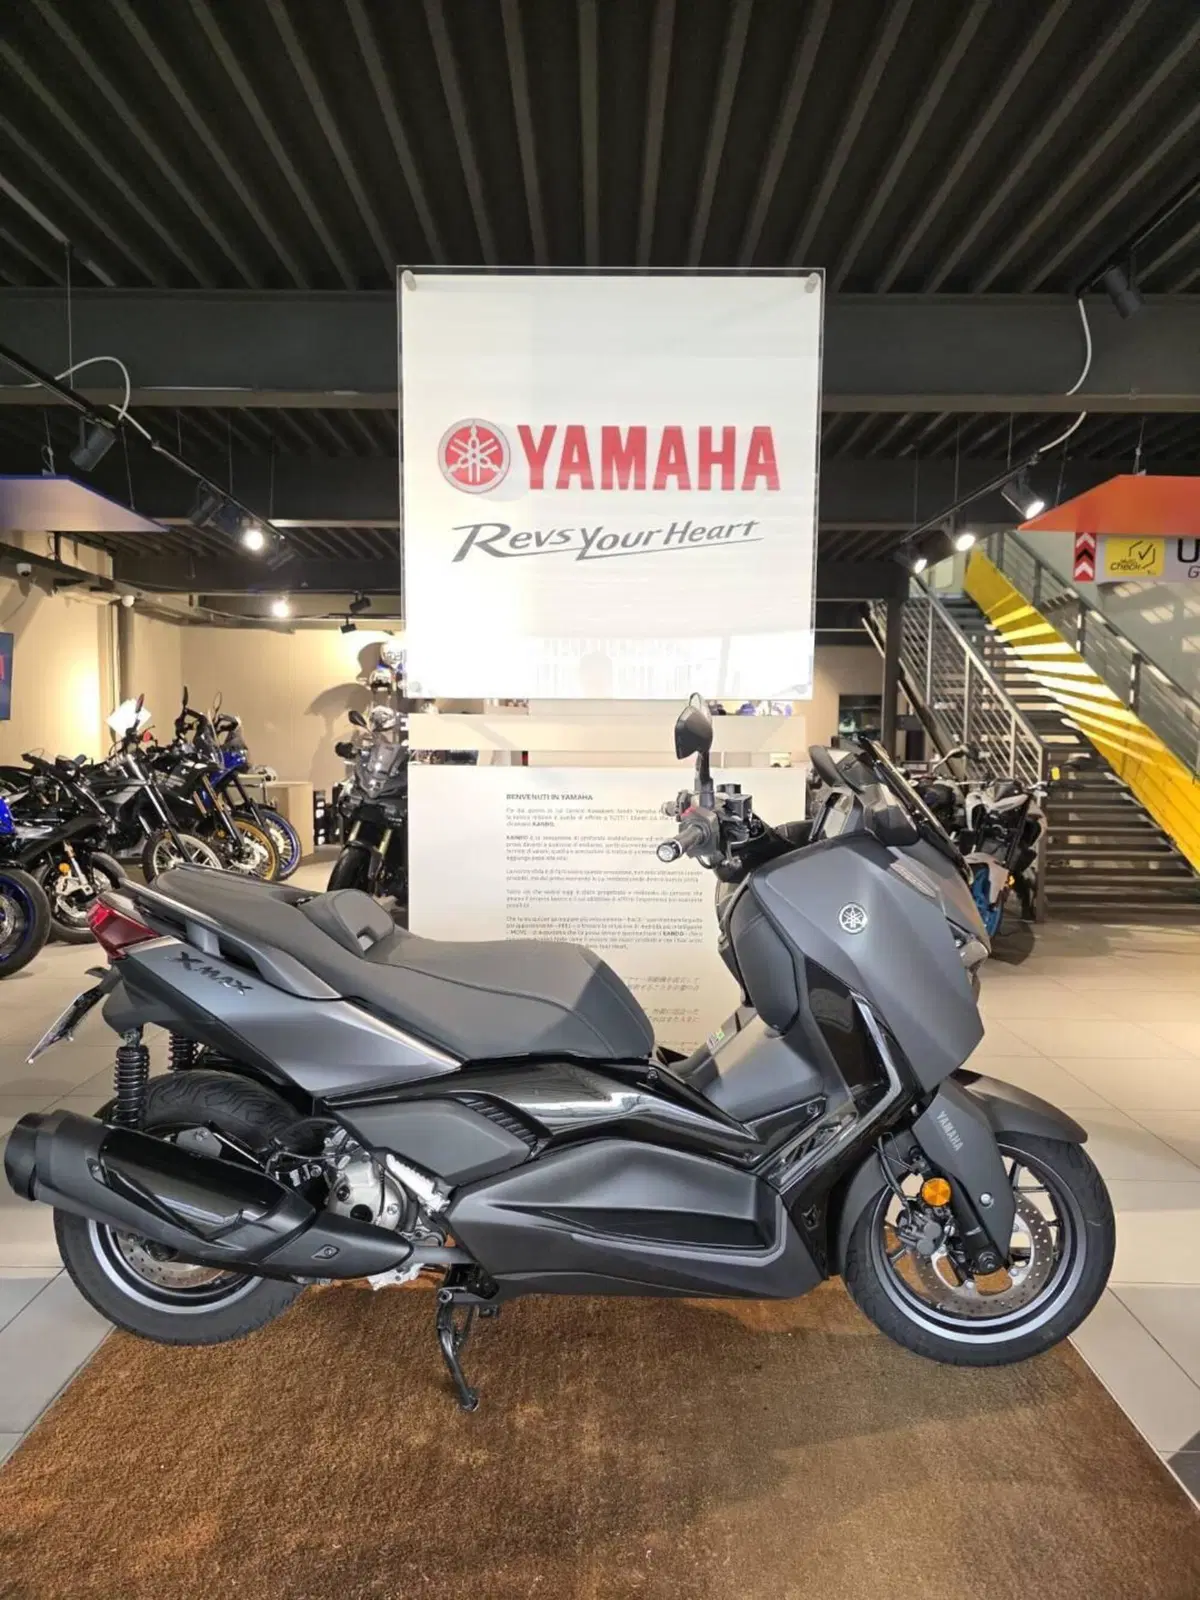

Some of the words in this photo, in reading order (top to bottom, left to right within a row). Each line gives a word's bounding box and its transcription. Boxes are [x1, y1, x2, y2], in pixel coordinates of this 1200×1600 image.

[516, 424, 781, 491] YAMAHA
[452, 522, 576, 562] Revs
[576, 525, 664, 561] Your
[663, 519, 761, 546] Heart
[506, 793, 550, 801] BENVENUTI
[551, 793, 559, 801] IN
[561, 793, 594, 801] YAMAHA
[936, 1110, 964, 1151] YAMAHA
